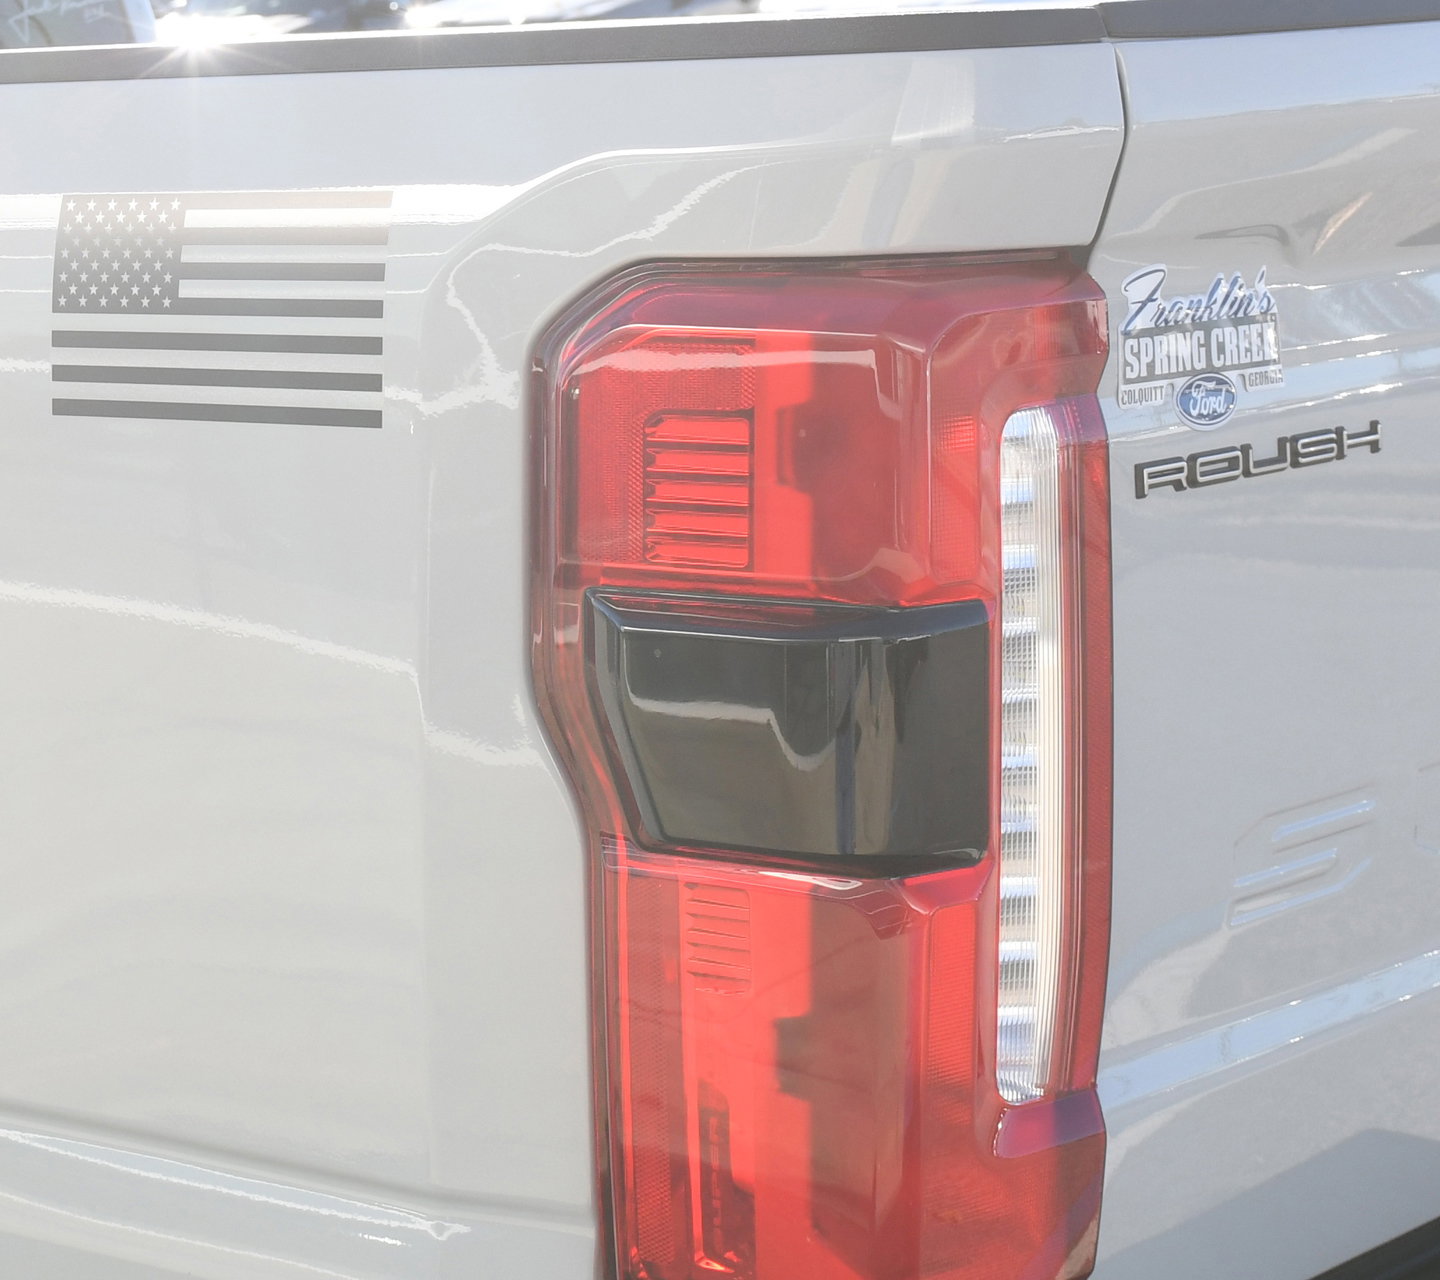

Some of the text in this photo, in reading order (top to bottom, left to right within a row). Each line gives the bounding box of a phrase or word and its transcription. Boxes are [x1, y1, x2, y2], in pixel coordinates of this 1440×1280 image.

[1121, 268, 1276, 336] Franklin's
[1124, 329, 1206, 379] SPRING
[1121, 385, 1165, 406] COLQUITT
[1189, 380, 1227, 417] Ford
[1134, 420, 1382, 500] ROUSH
